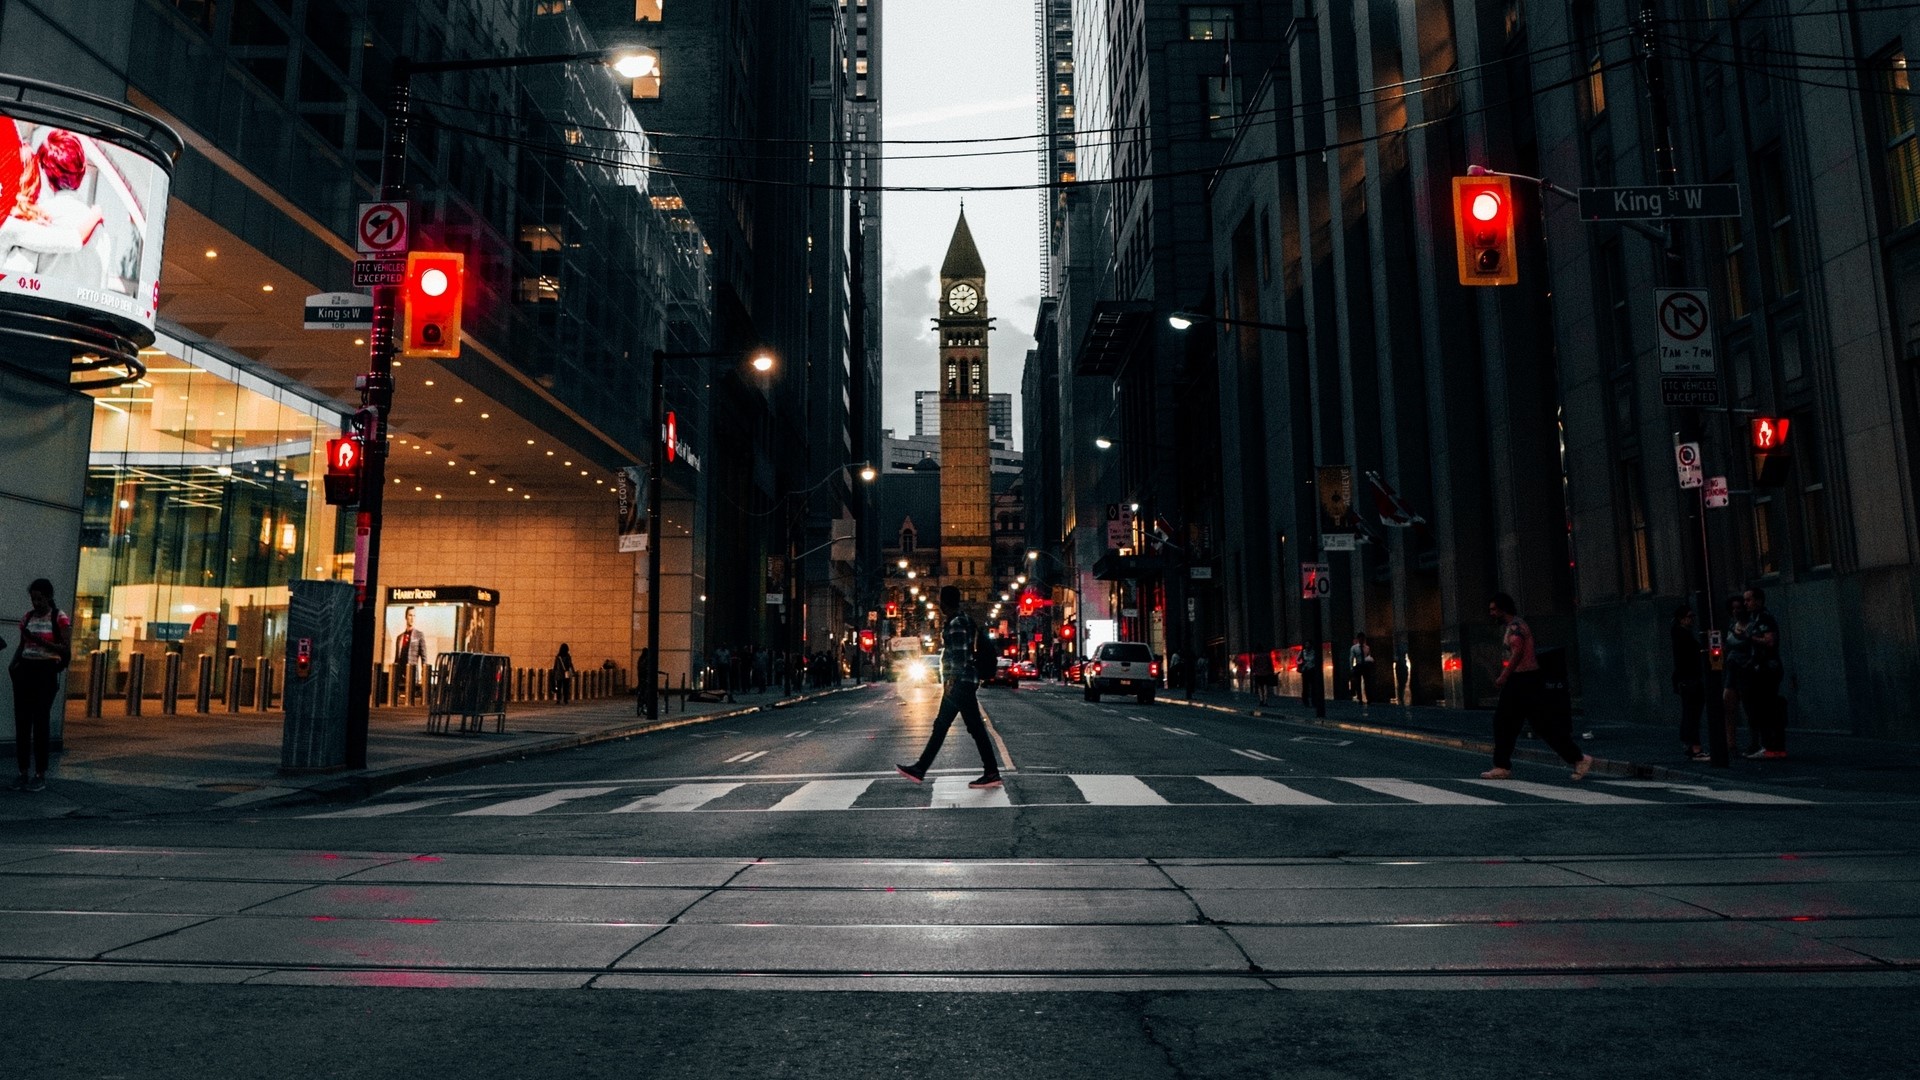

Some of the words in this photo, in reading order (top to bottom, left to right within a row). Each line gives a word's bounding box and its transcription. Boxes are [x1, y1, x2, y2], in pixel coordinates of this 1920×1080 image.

[1614, 190, 1662, 216] King
[1668, 190, 1679, 201] St
[1684, 188, 1702, 209] W
[357, 263, 370, 272] TTC
[373, 263, 405, 272] VEHICLES
[357, 273, 403, 283] EXCEPTED
[77, 287, 99, 302] PEYTO
[318, 307, 340, 321] King
[342, 310, 350, 319] St
[352, 308, 360, 318] W
[1663, 381, 1679, 391] TTC
[1681, 381, 1717, 391] VEHICLES
[1666, 392, 1716, 403] EXCEPTED
[618, 472, 628, 515] DISCOVER
[1340, 469, 1351, 506] ACHIEVE
[1304, 577, 1329, 594] 40
[393, 589, 415, 600] HARRY
[414, 588, 436, 600] ROSEN
